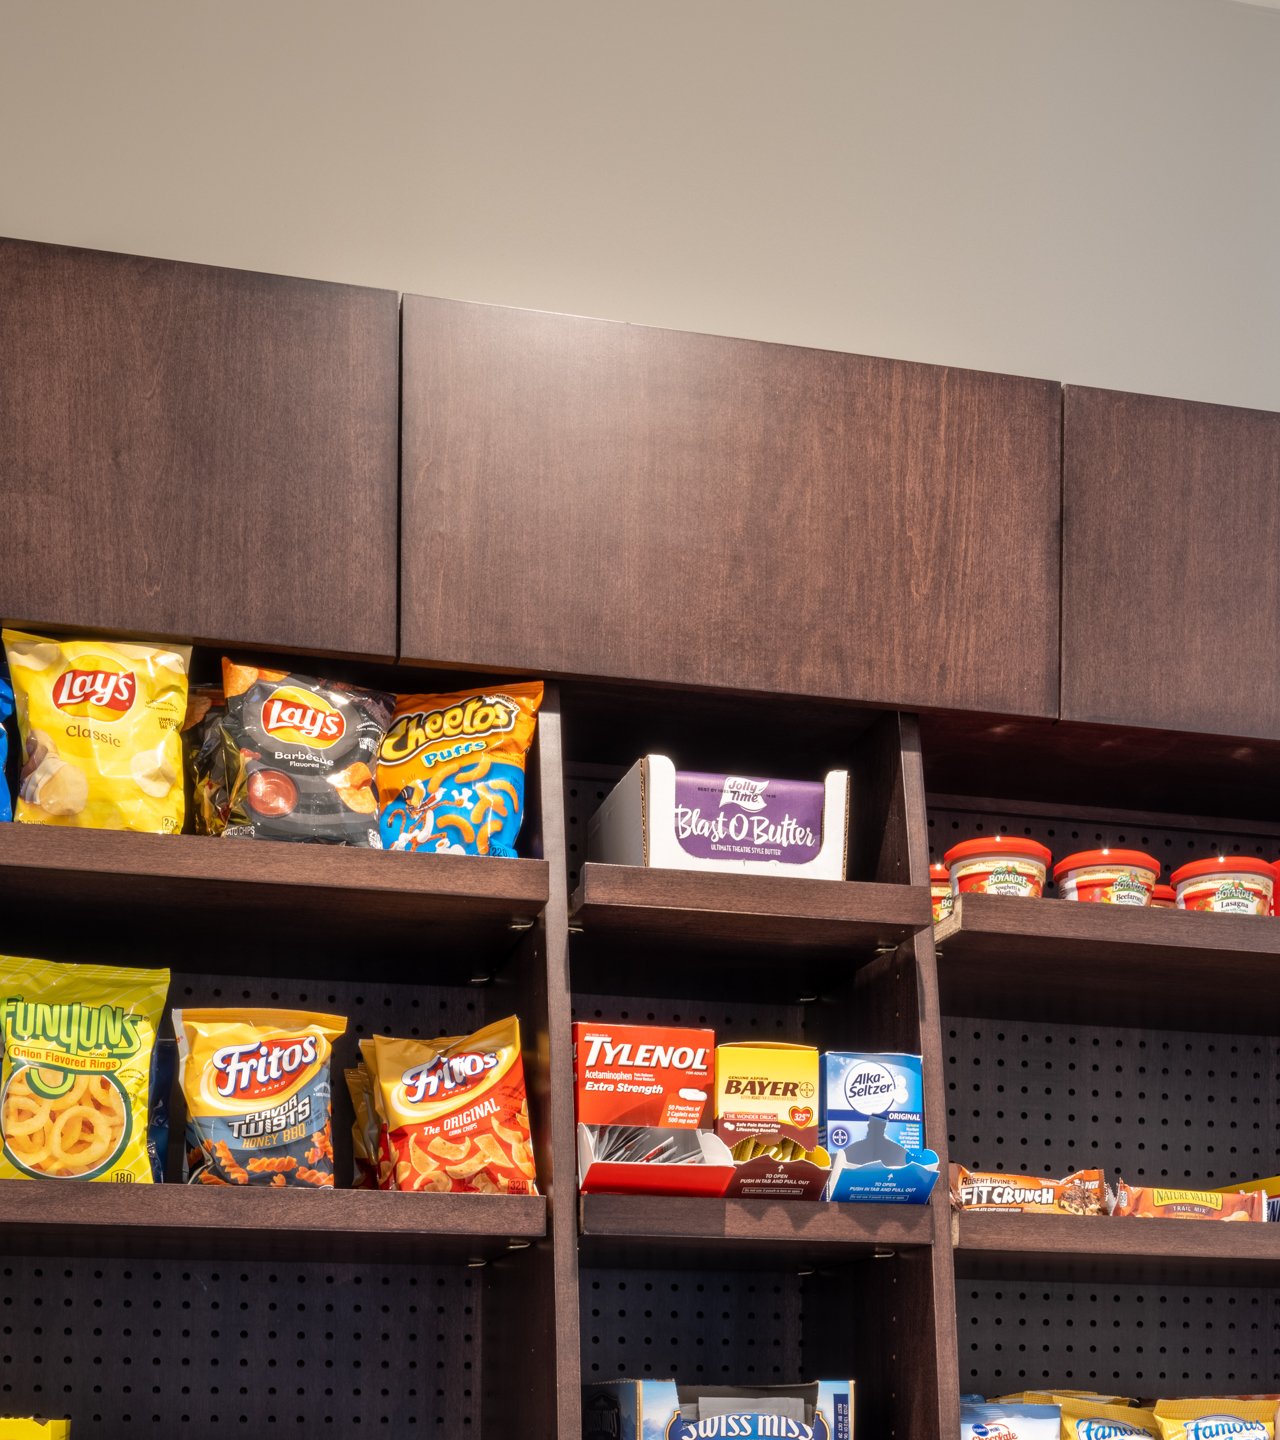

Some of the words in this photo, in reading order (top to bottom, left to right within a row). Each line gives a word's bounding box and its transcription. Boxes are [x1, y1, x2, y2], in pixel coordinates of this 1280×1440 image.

[58, 671, 133, 706] Lay's
[268, 700, 341, 737] Lay's
[381, 699, 513, 760] Cheetos
[66, 725, 121, 748] Classic
[275, 752, 334, 766] Barbecue
[423, 741, 487, 767] Puffs
[728, 780, 757, 793] Jolly
[731, 791, 759, 803] Time
[675, 804, 726, 842] Blast
[729, 813, 748, 841] O
[750, 814, 815, 847] Butter
[710, 844, 732, 852] ULTIMATE
[989, 873, 1026, 887] BOYARDEE
[1220, 900, 1249, 910] Lasagna
[0, 994, 142, 1059] FUNYUNS
[13, 1047, 42, 1060] Onion
[45, 1051, 86, 1068] Flavored
[89, 1059, 117, 1070] Rings
[584, 1036, 707, 1070] TYLENOL
[212, 1035, 317, 1098] Fritos
[402, 1050, 498, 1104] Fritos
[585, 1070, 632, 1081] Acetaminophen
[585, 1082, 614, 1091] Extra
[616, 1083, 663, 1095] Strength
[725, 1080, 799, 1097] BAYER
[848, 1083, 892, 1098] Seltzer
[851, 1073, 885, 1086] Alka-
[245, 1094, 298, 1123] FLAVOR
[423, 1124, 440, 1136] The
[442, 1098, 501, 1131] ORIGINAL
[242, 1132, 277, 1148] HONEY
[282, 1123, 306, 1143] BBQ
[115, 1173, 132, 1183] 180
[1156, 1190, 1189, 1204] NATURE
[1188, 1192, 1220, 1207] VALLEY
